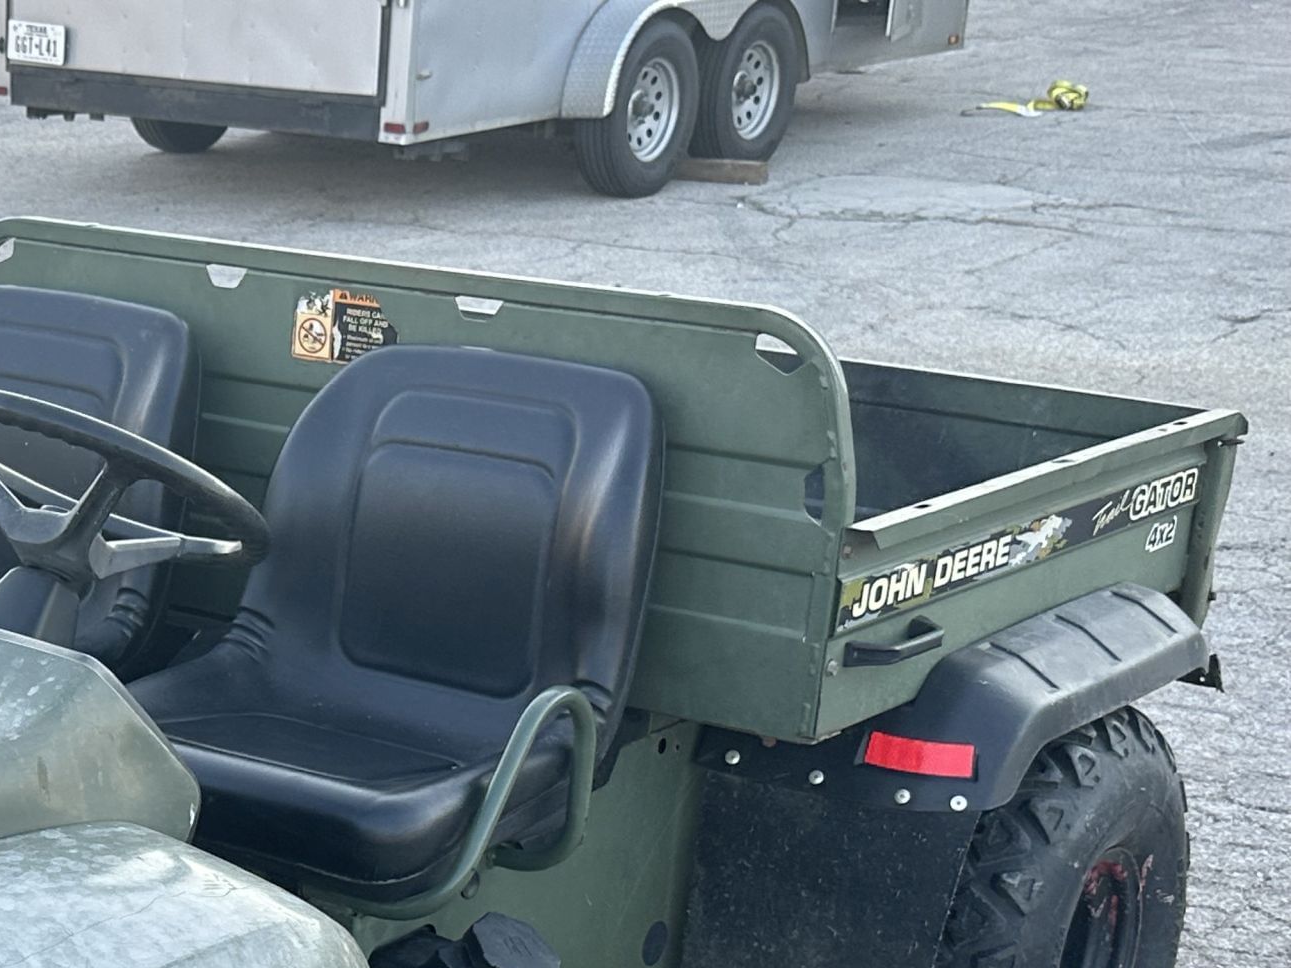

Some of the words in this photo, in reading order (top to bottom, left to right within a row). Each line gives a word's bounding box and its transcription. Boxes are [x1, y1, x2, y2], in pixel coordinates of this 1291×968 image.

[342, 316, 359, 324] FALL
[359, 318, 373, 326] OFF
[374, 320, 389, 329] AND
[348, 324, 357, 332] BE
[1130, 467, 1198, 521] GATOR
[852, 562, 927, 617] JOHN
[933, 534, 1013, 587] DEERE
